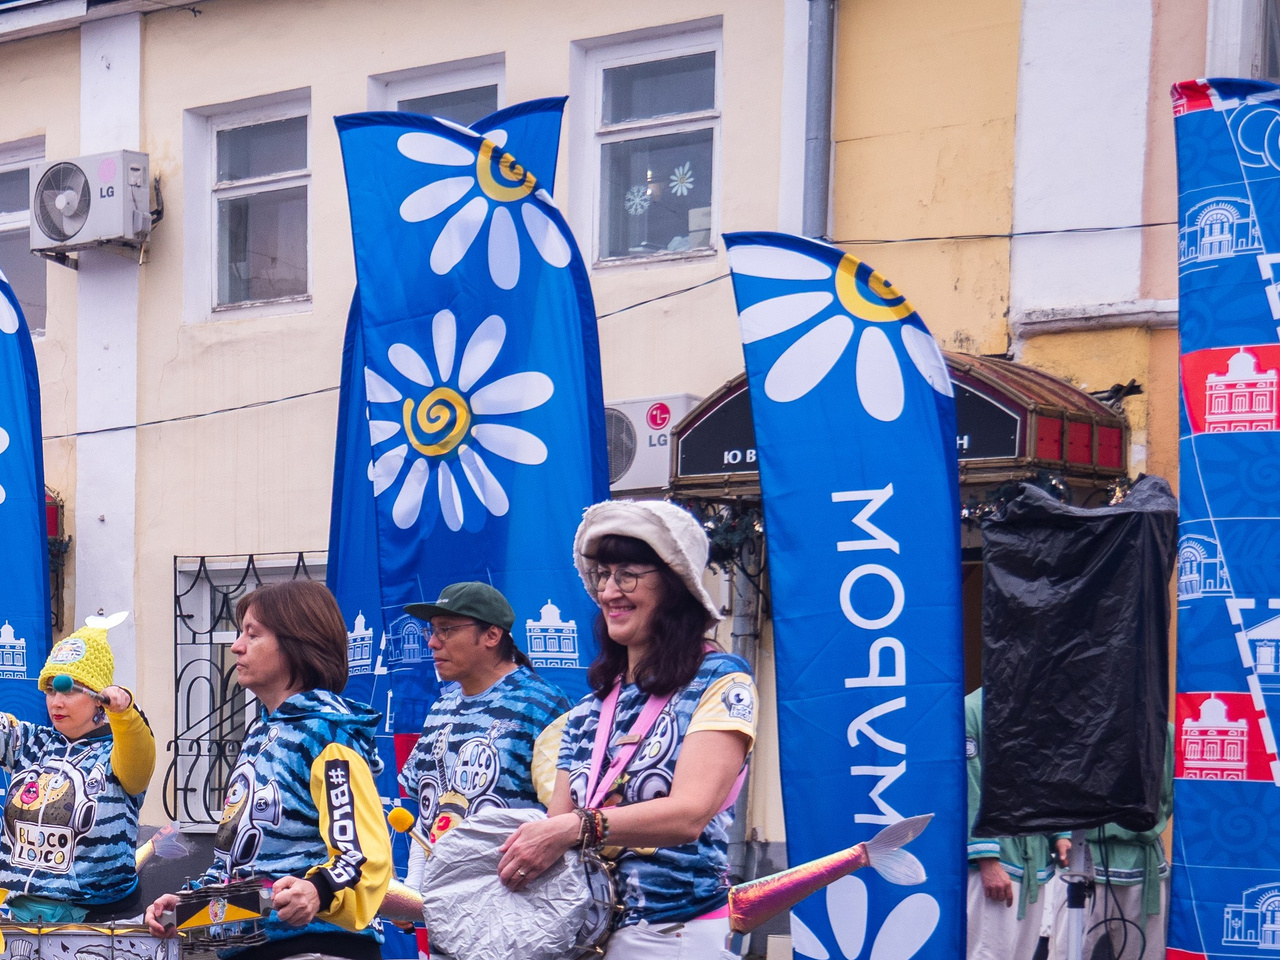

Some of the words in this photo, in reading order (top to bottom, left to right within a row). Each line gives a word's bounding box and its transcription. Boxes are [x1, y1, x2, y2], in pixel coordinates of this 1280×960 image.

[100, 186, 115, 198] LG
[648, 433, 668, 447] LG
[19, 827, 68, 849] BLOCO
